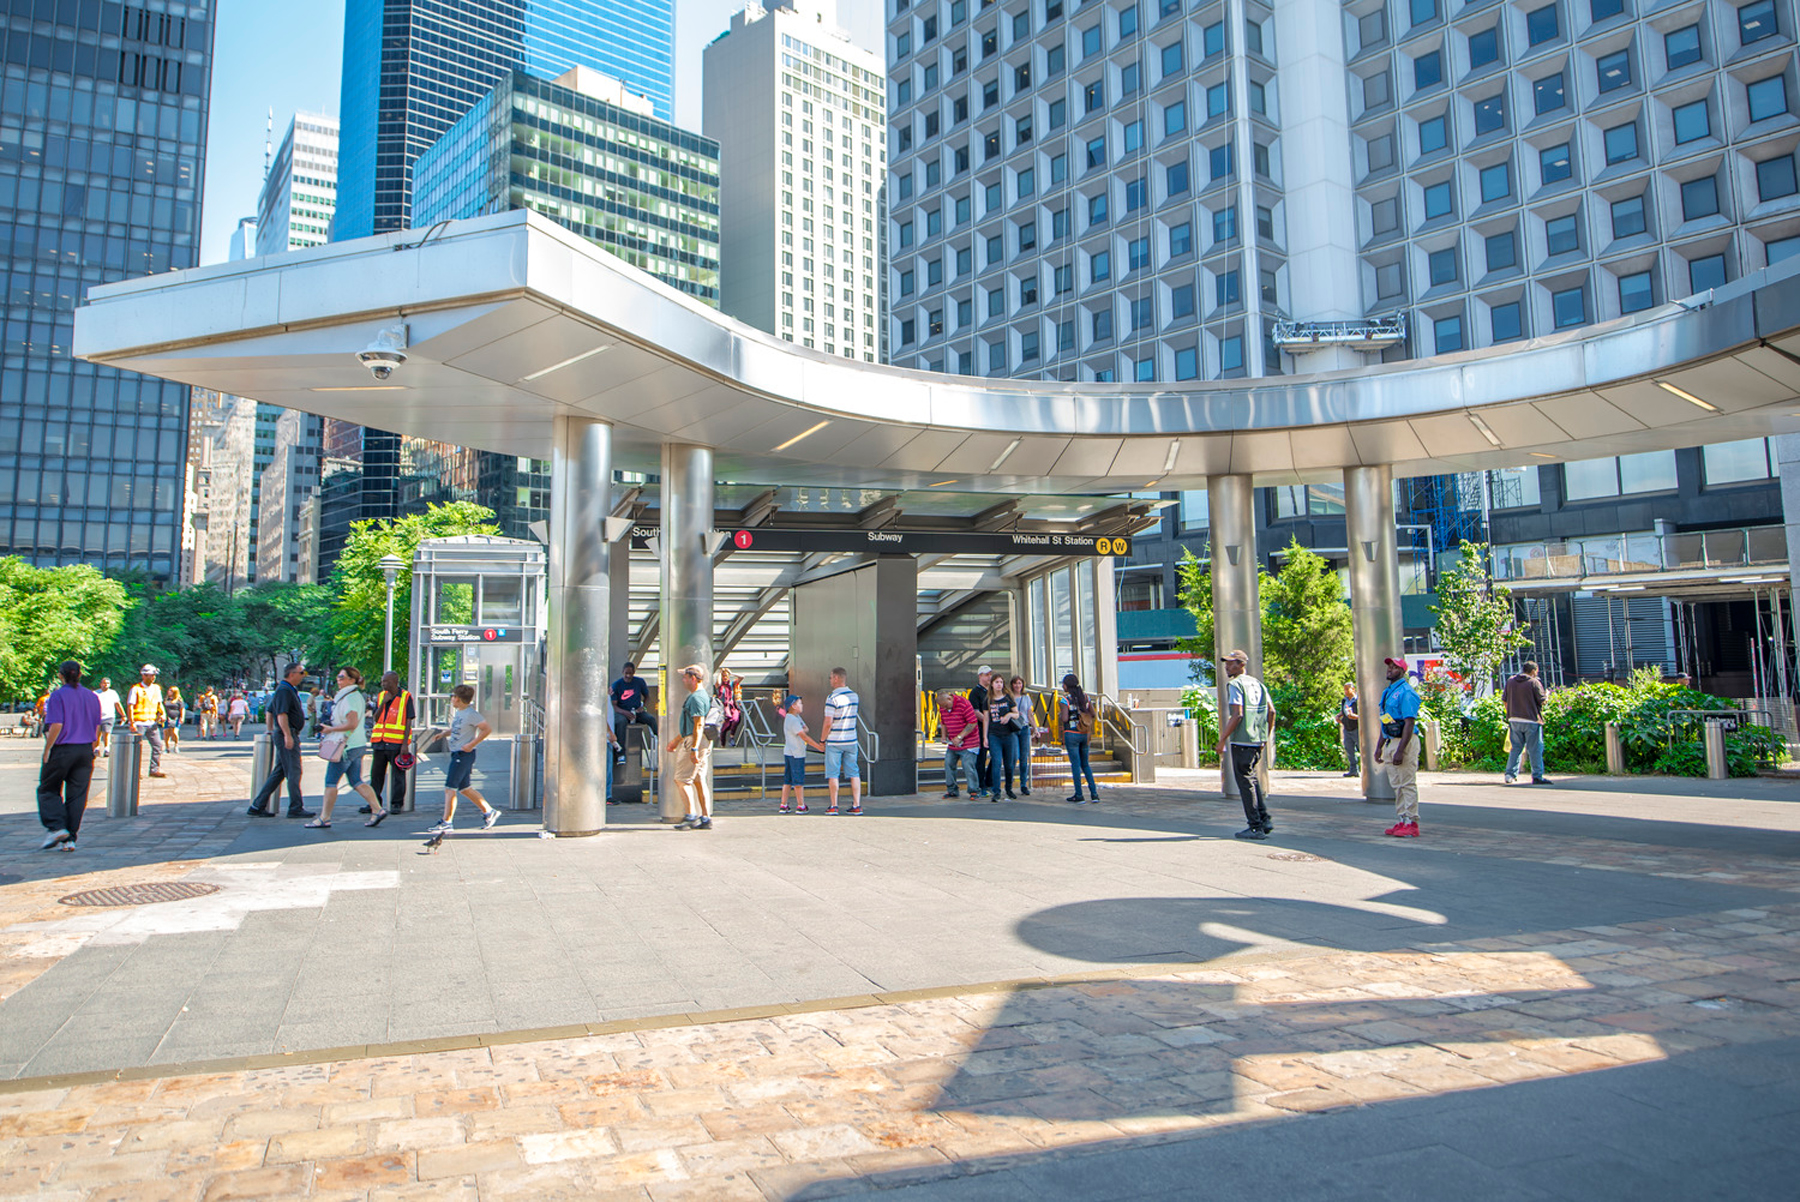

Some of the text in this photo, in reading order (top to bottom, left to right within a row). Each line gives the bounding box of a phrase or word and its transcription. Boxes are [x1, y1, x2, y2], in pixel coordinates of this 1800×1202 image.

[867, 531, 903, 543] Subway
[1012, 535, 1094, 546] Whitehall St Station
[451, 628, 469, 636] Ferry
[431, 634, 456, 642] Subway
